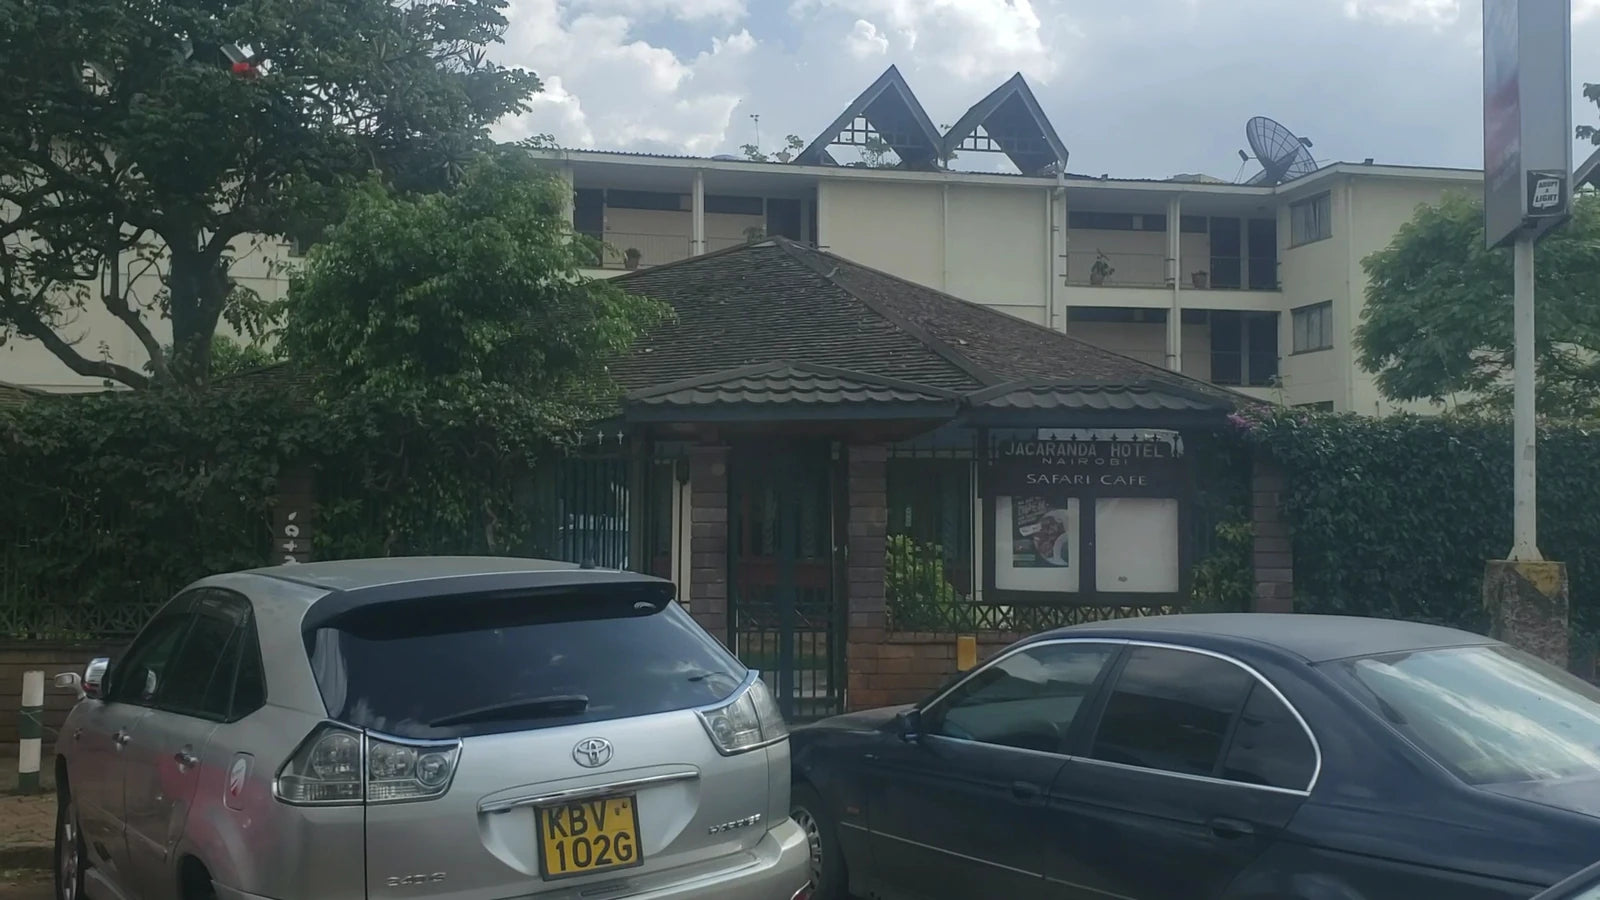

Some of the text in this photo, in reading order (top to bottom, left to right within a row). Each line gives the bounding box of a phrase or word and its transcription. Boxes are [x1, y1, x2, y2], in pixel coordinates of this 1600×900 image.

[1535, 194, 1557, 202] LIGHT
[1005, 442, 1164, 458] JACARANDA HOTEL
[1042, 457, 1128, 466] NAIROBI
[1026, 473, 1148, 486] SAFARI CAFE
[548, 800, 607, 840] KBV
[555, 831, 633, 872] 102G
